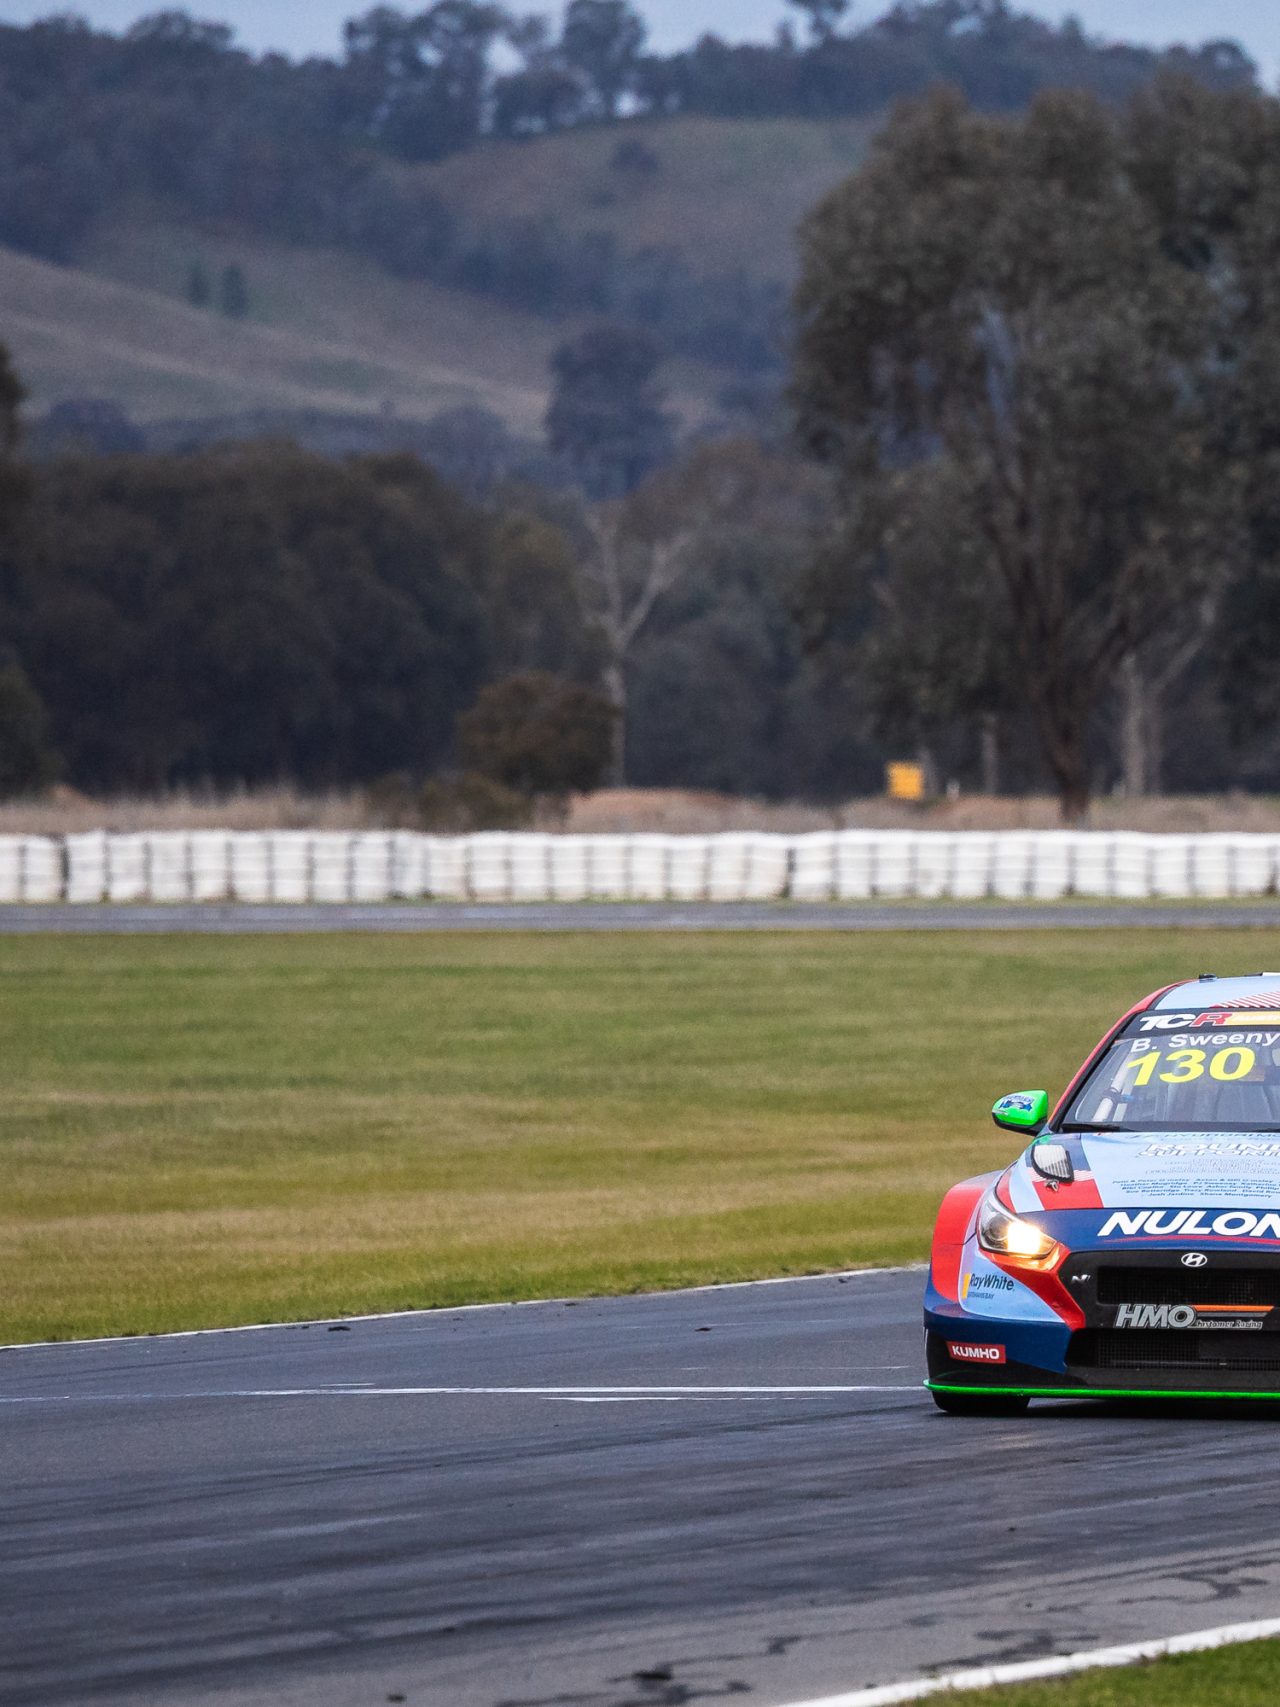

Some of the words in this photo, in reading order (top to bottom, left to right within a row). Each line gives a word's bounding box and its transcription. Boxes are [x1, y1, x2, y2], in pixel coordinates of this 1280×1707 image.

[1139, 1012, 1233, 1032] TCR
[1130, 1038, 1158, 1053] B.
[1127, 1046, 1256, 1087] 130
[1113, 1303, 1197, 1329] HMO
[951, 1345, 1000, 1360] KUMHO
